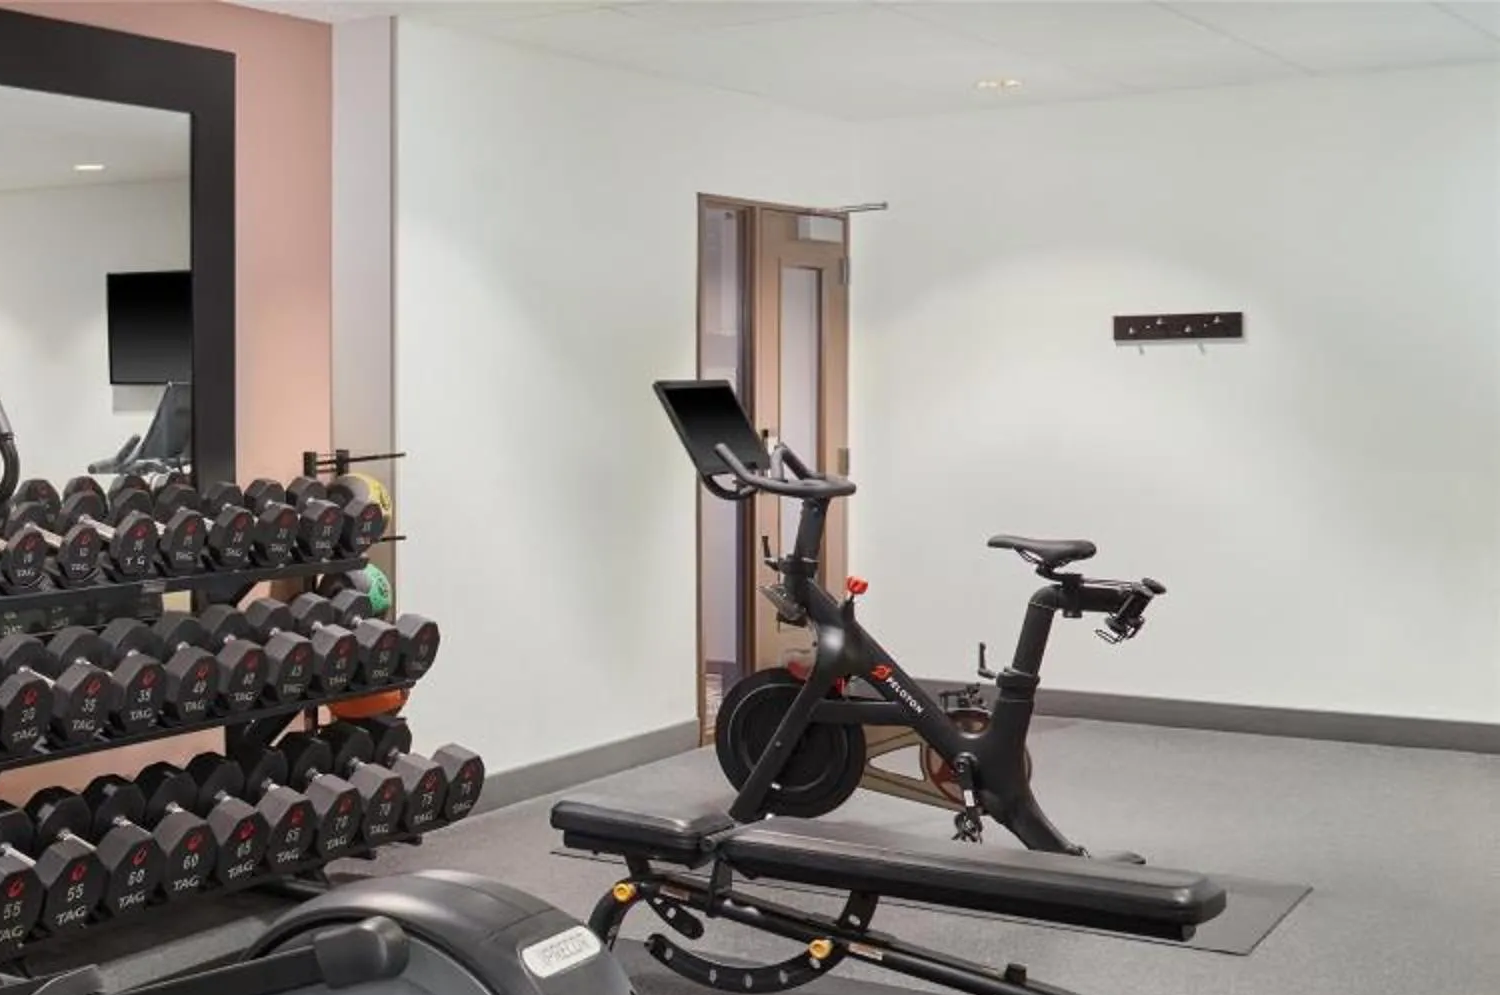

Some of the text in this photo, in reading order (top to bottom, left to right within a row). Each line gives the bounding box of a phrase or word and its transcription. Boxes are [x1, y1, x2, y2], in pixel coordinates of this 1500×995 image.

[885, 676, 924, 713] PELOTON
[228, 860, 254, 878] TAG
[67, 883, 84, 902] 55
[173, 875, 200, 891] TAG
[119, 891, 146, 909] TAG
[3, 901, 23, 920] 55
[55, 905, 87, 926] TAG
